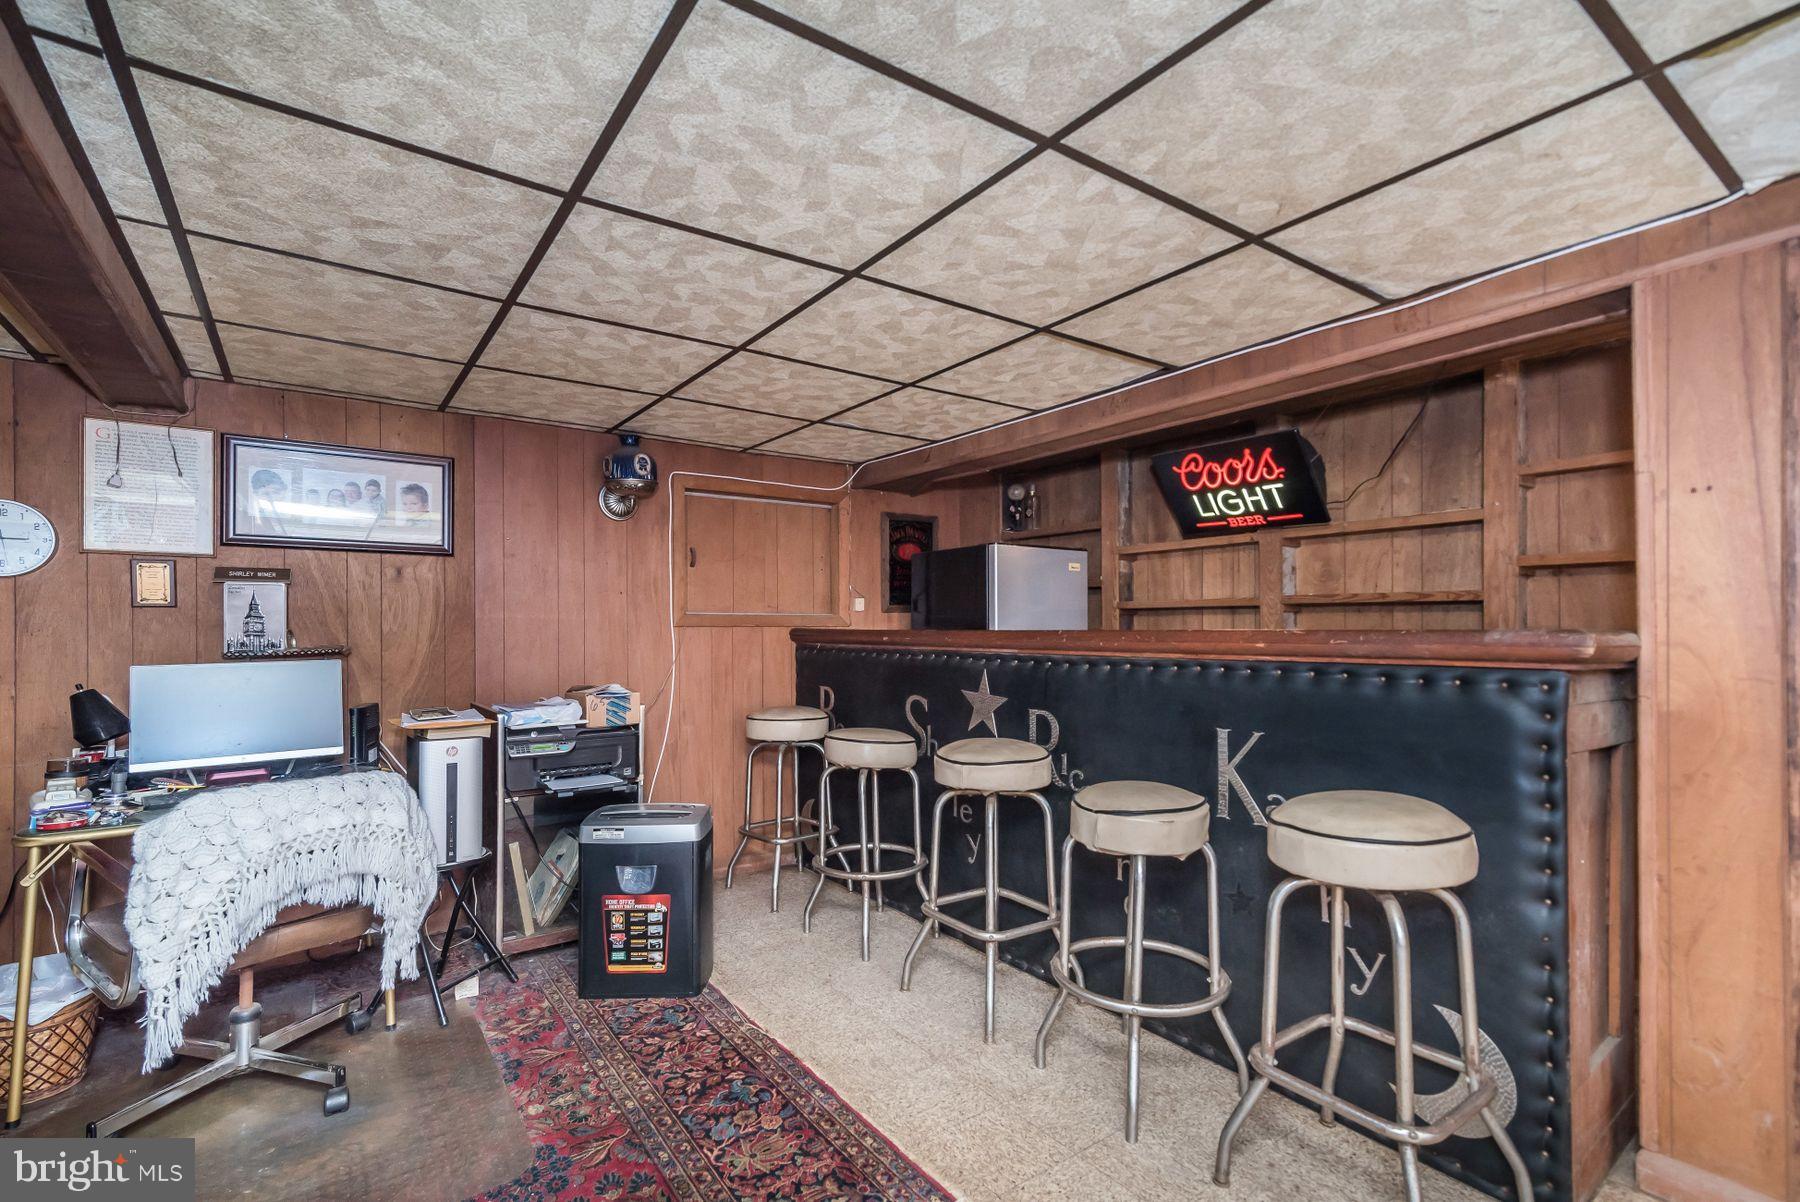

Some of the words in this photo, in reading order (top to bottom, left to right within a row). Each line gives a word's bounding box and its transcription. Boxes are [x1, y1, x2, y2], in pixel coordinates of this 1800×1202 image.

[1172, 448, 1285, 491] Coors
[1193, 483, 1284, 518] LIGHT
[34, 523, 40, 531] 2
[1227, 515, 1268, 528] BEER
